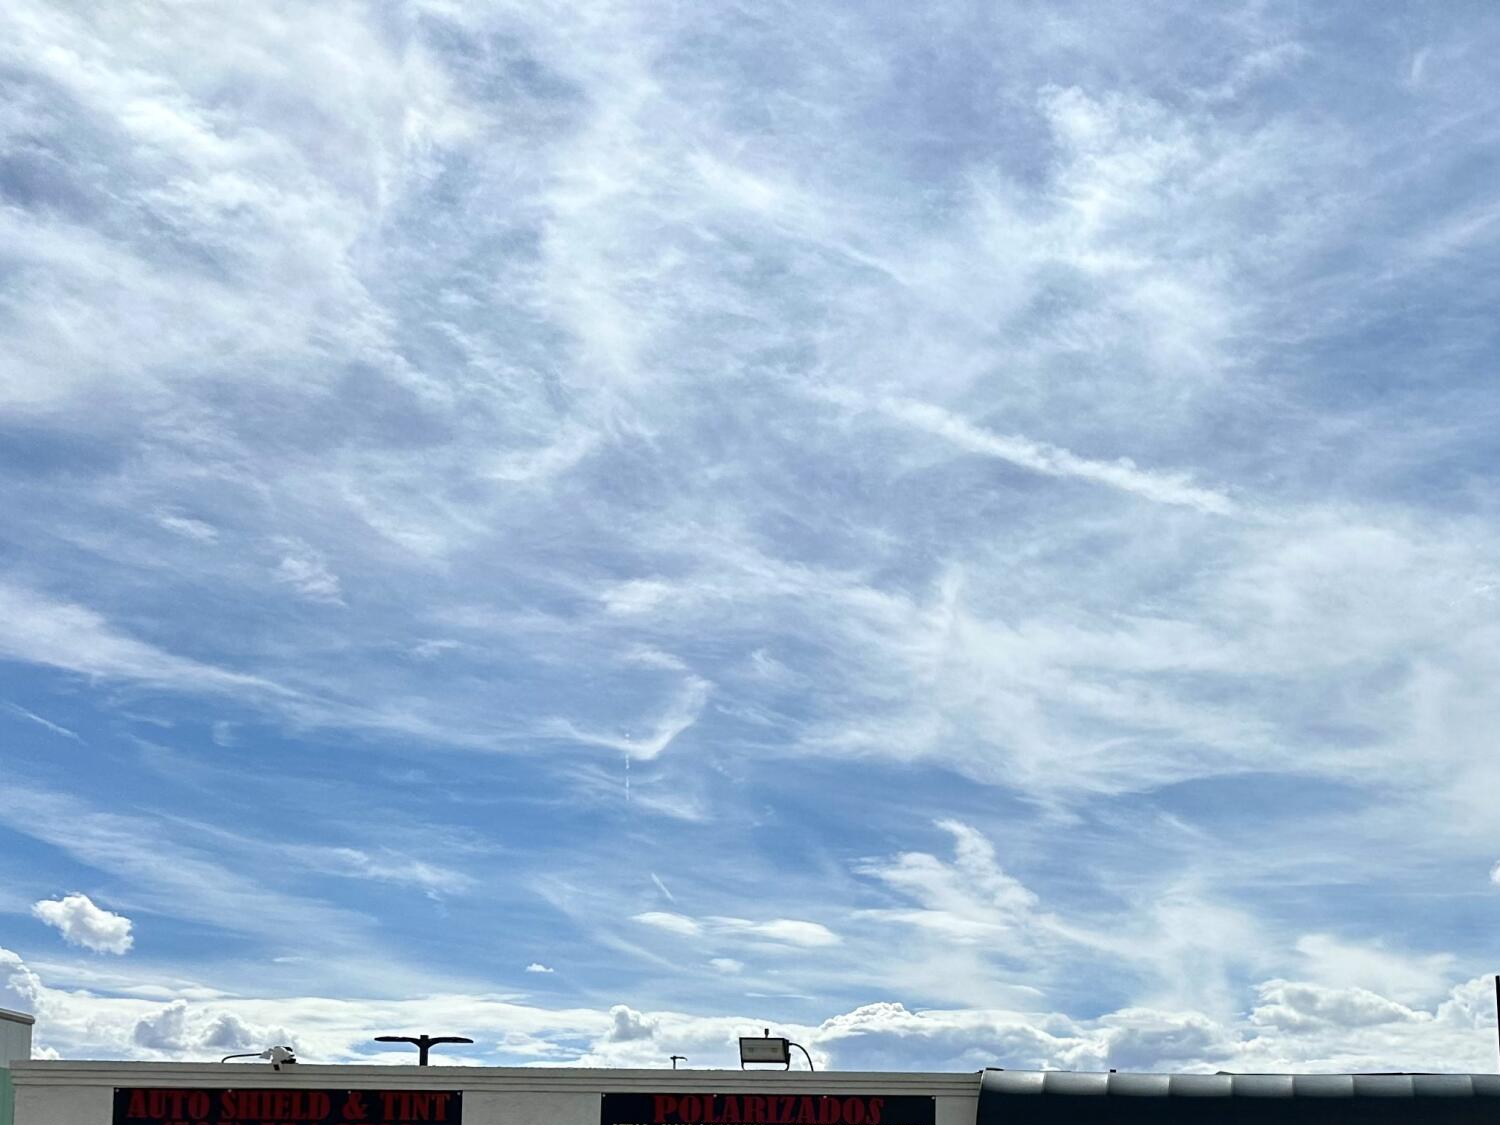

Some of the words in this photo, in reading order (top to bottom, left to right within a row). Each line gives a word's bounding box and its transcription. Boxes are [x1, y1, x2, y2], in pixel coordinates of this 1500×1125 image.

[126, 1090, 211, 1120] AUTO
[221, 1090, 332, 1120] SHIELD
[341, 1091, 369, 1120] &
[378, 1092, 451, 1121] TINT
[653, 1094, 884, 1124] POLARIZADOS
